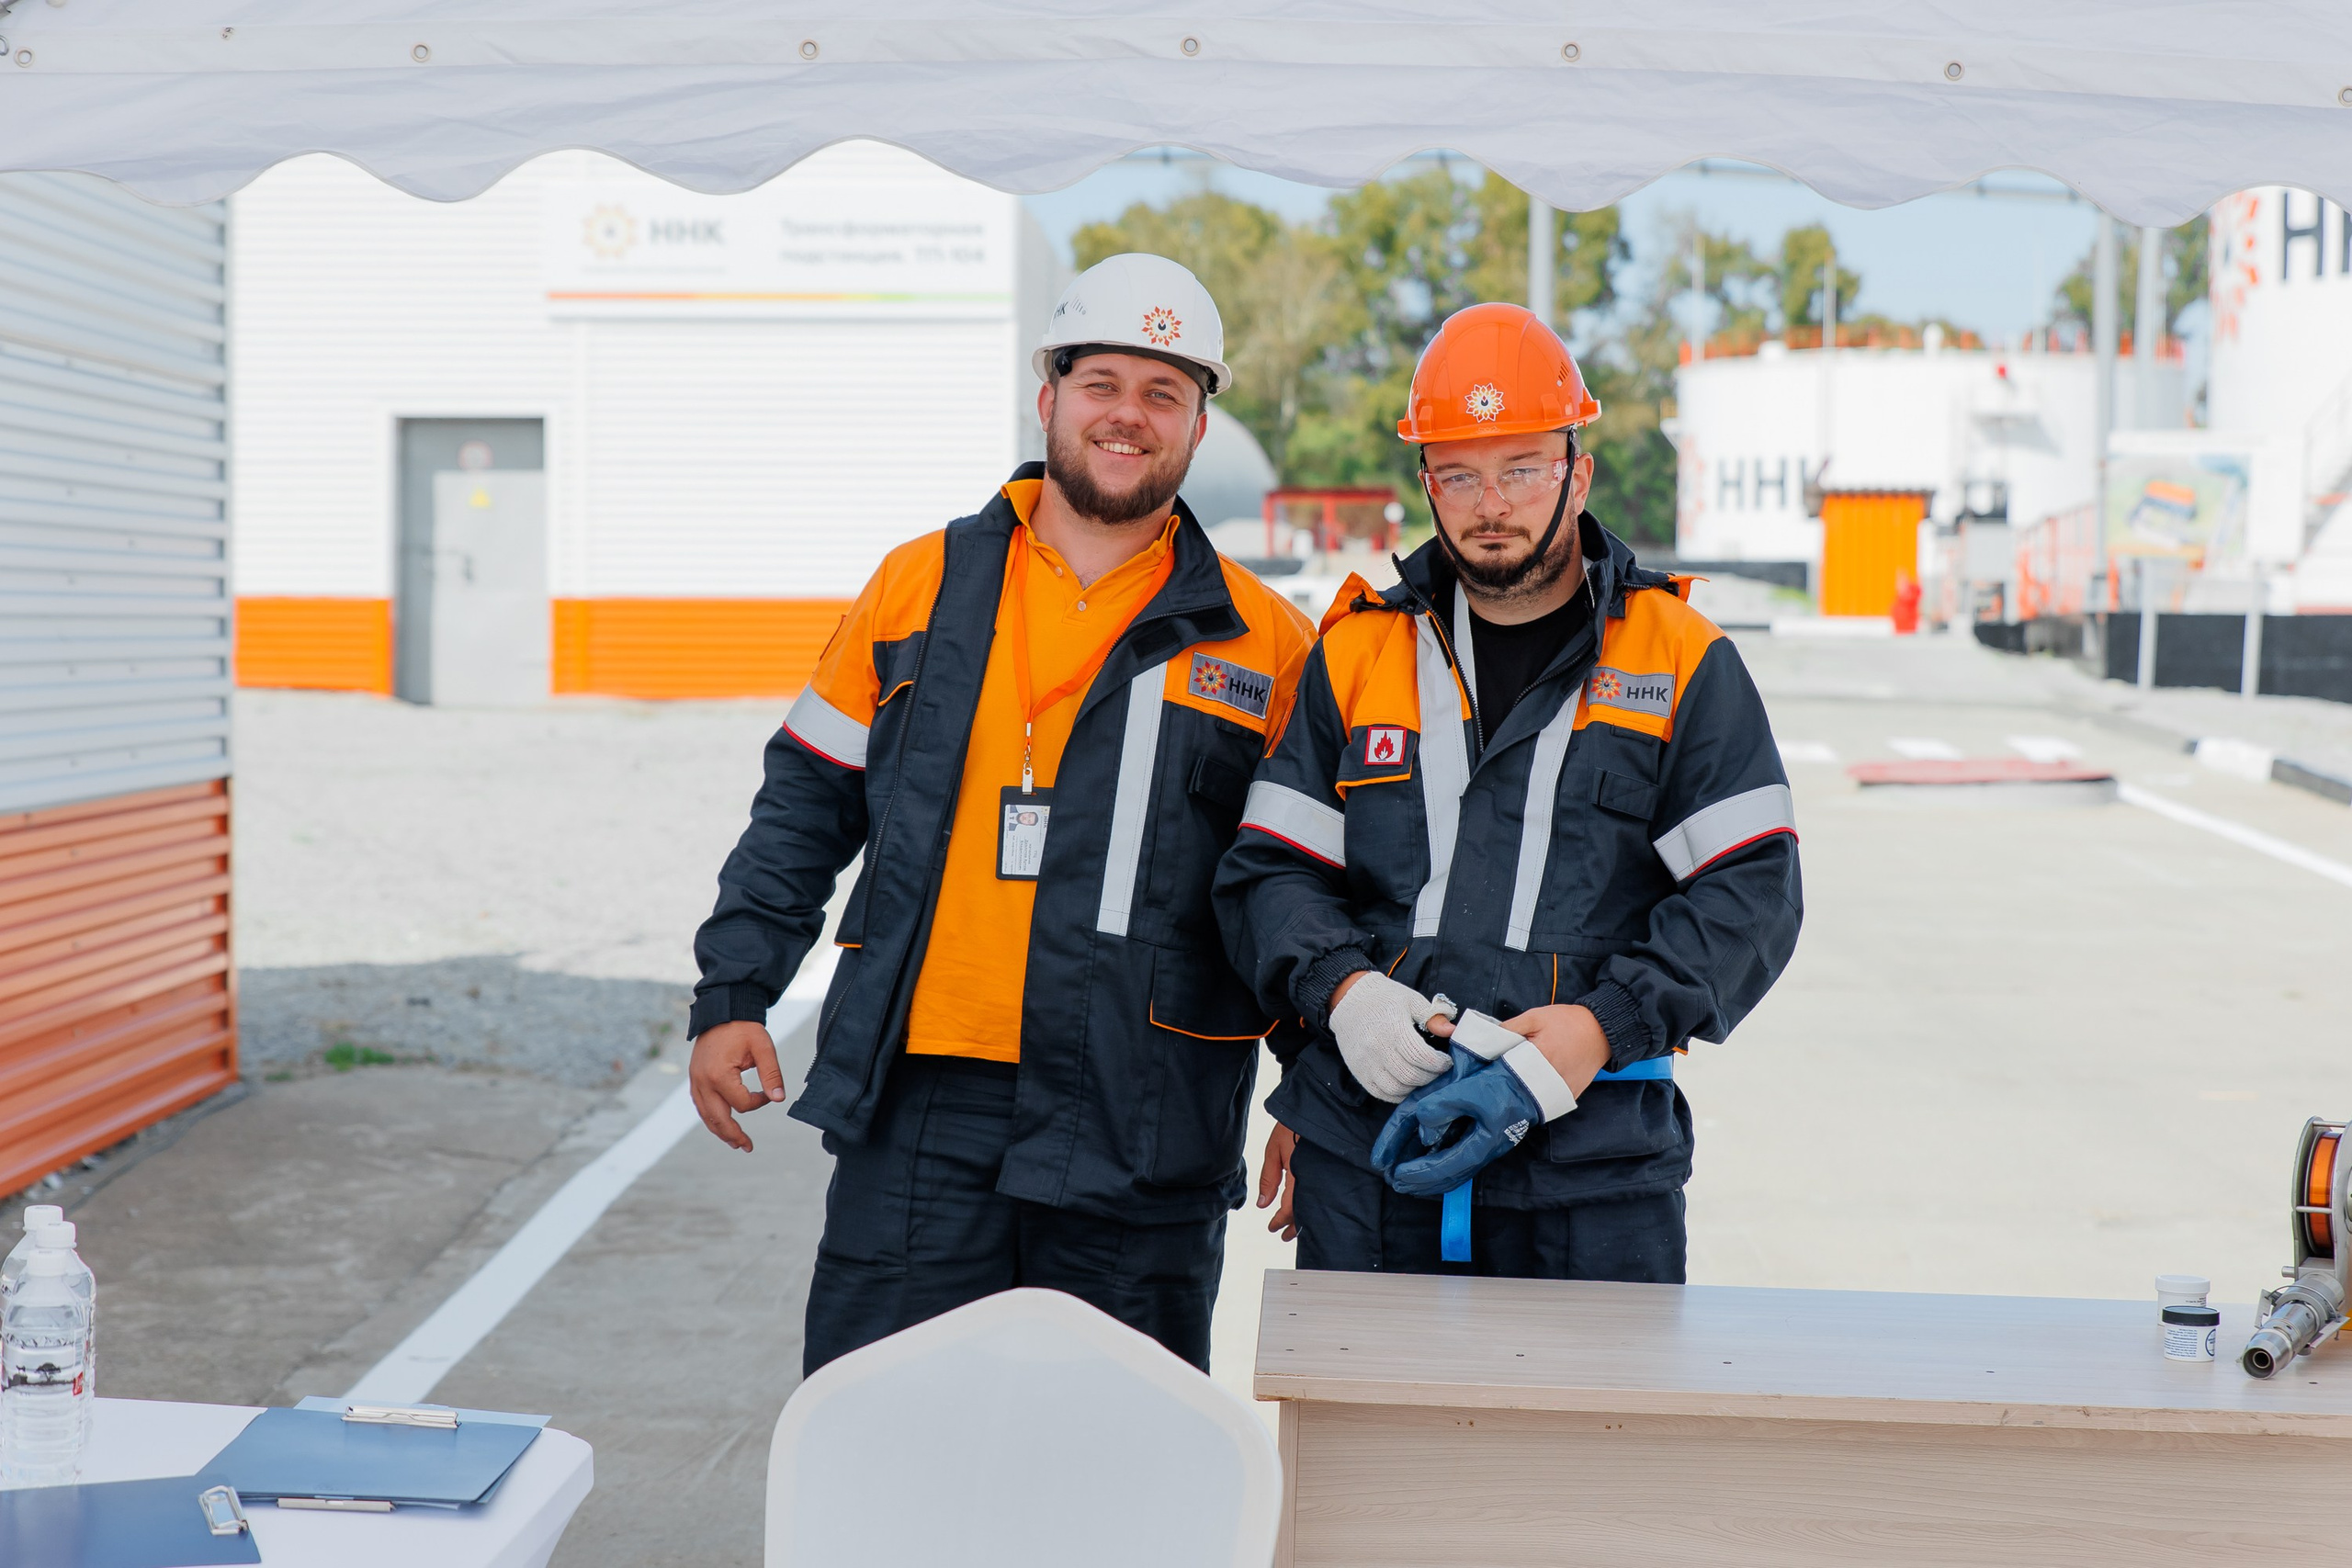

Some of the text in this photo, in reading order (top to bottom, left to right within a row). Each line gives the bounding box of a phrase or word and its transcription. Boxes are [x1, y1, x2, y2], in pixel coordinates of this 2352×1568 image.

[649, 219, 726, 245] ННК
[1228, 677, 1267, 704] ННК
[1626, 686, 1669, 704] ННК
